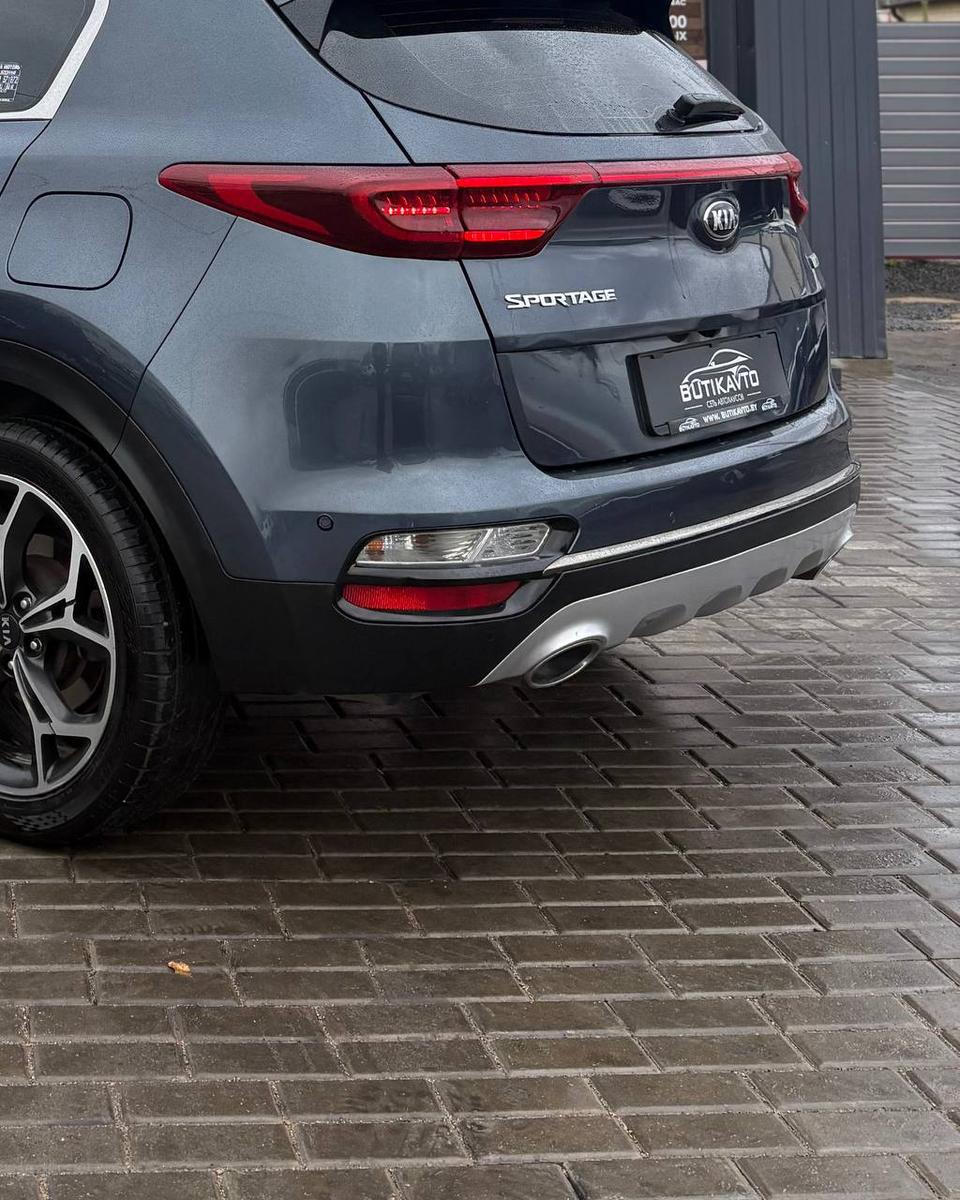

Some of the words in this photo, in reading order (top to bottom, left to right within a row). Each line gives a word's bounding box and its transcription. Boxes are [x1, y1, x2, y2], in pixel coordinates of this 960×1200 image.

[712, 208, 737, 231] KIA
[504, 288, 617, 309] SPORTAGE
[680, 370, 760, 402] BUTIKAVTO
[1, 616, 12, 646] KIA
